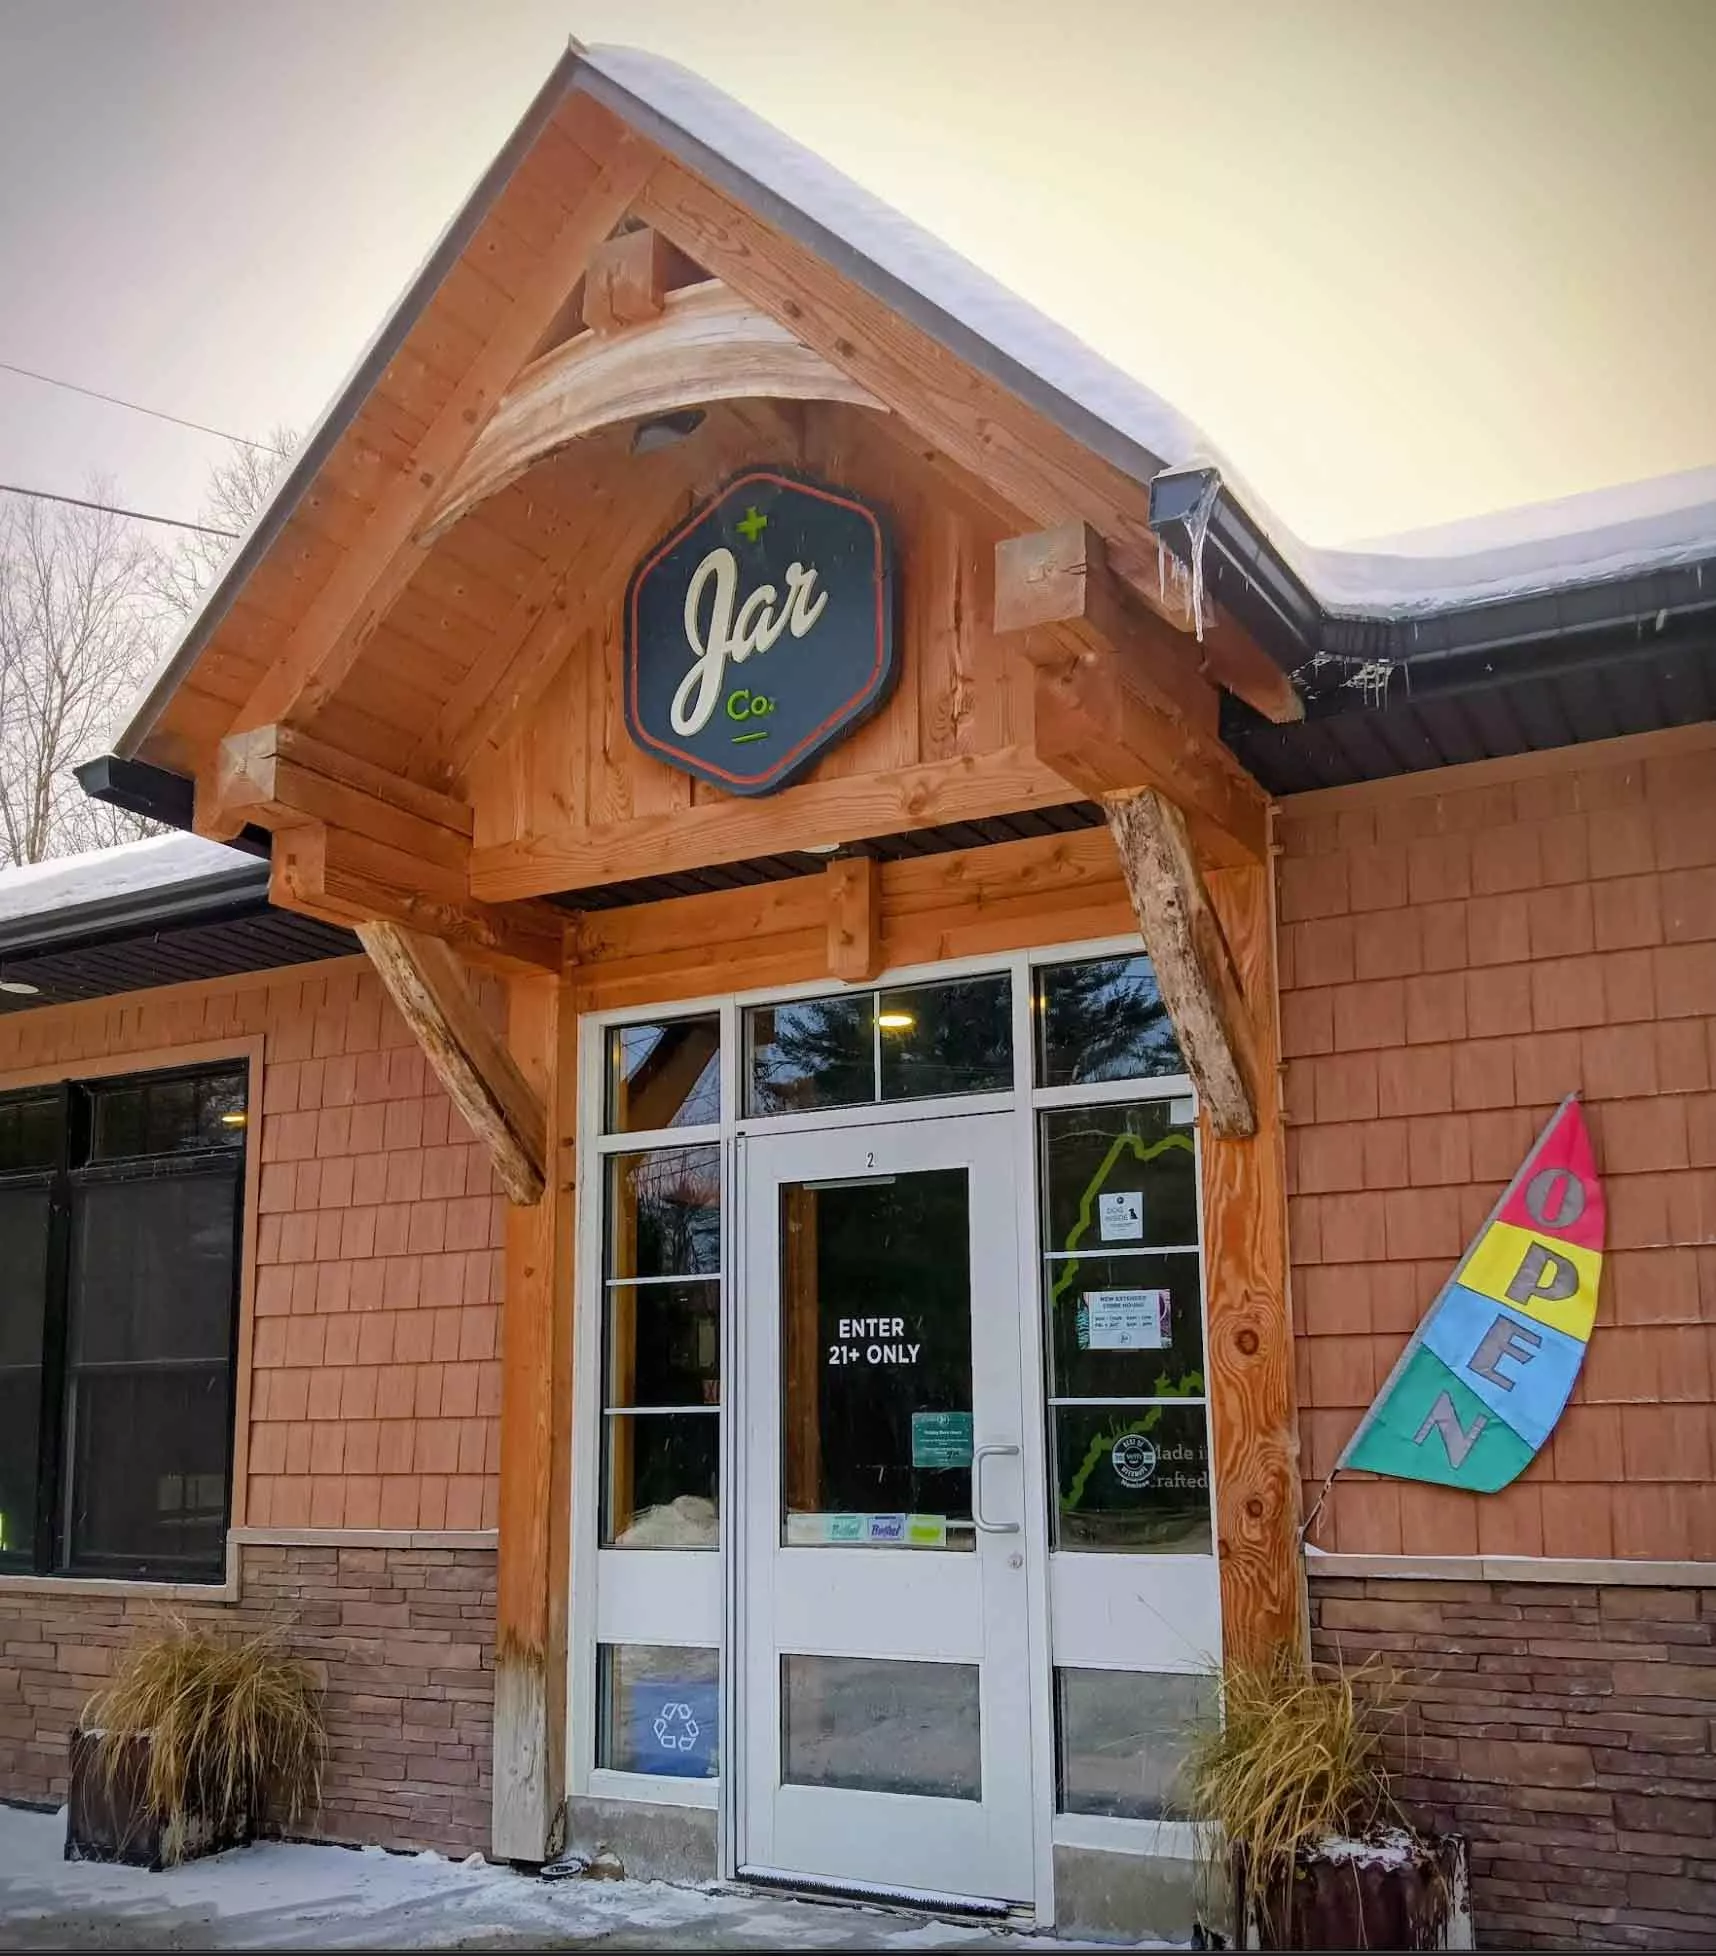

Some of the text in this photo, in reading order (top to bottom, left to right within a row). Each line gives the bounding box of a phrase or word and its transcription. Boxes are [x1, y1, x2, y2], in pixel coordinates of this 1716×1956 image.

[670, 548, 829, 738] Jar
[727, 689, 774, 721] Co.
[866, 1152, 876, 1168] 2
[838, 1317, 905, 1339] ENTER
[1412, 1167, 1587, 1471] OPEN
[828, 1343, 921, 1365] 21+ ONLY
[1155, 1443, 1193, 1461] ade
[1149, 1470, 1209, 1488] rafted
